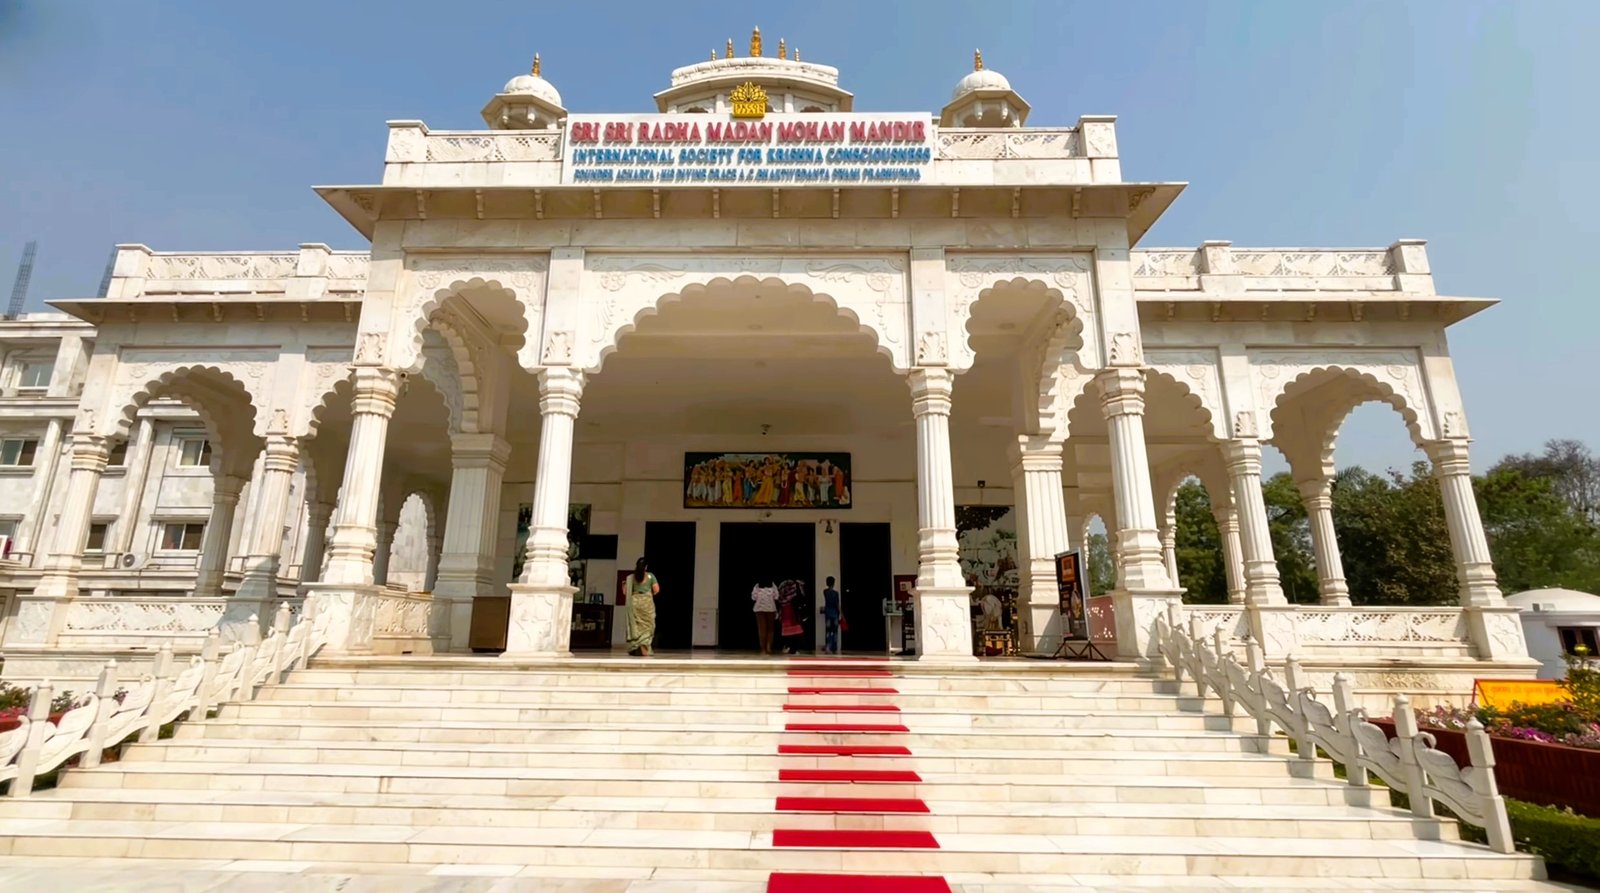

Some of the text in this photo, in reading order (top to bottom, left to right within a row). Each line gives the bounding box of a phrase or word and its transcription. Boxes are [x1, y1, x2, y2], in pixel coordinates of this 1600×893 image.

[570, 121, 926, 144] SRI SRI RADHA MADAN MOHAN MANDIR
[573, 148, 931, 164] INTERNATIONAL SOCIETY FOR KRISHNA CONSCIOUSNESS
